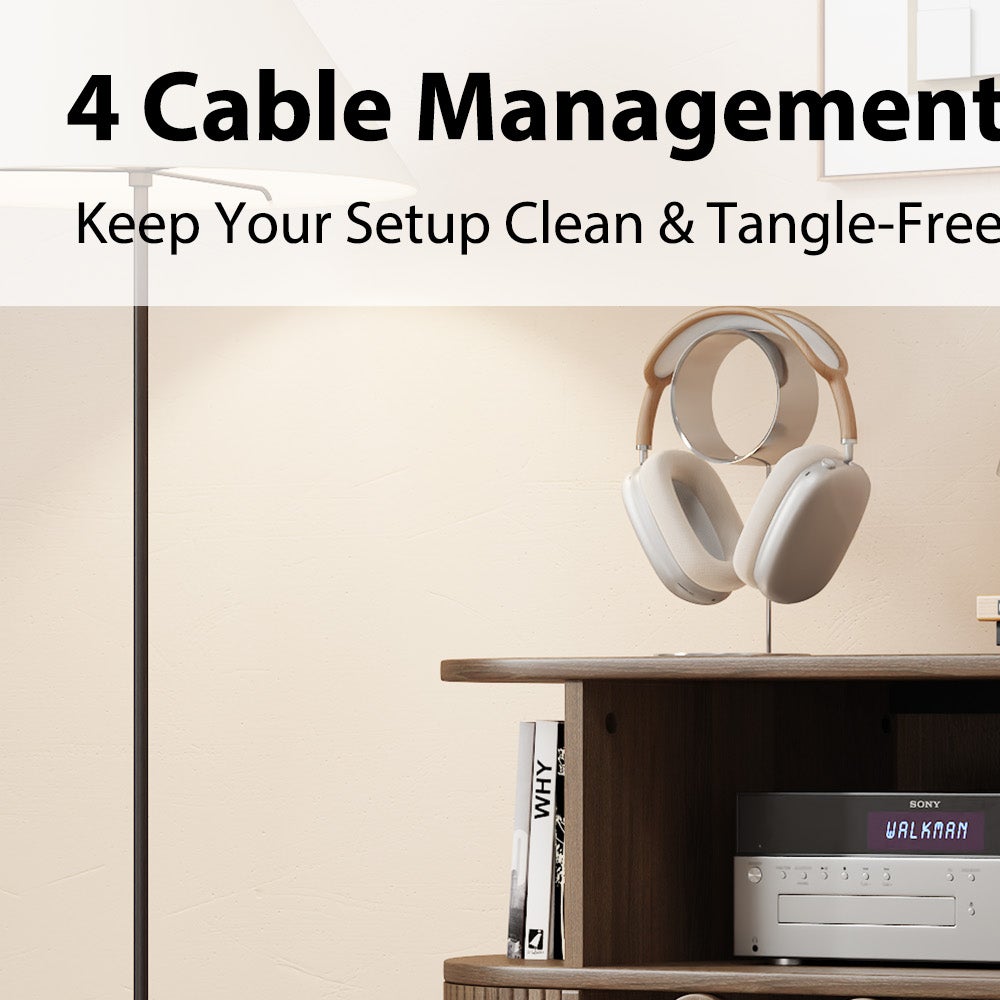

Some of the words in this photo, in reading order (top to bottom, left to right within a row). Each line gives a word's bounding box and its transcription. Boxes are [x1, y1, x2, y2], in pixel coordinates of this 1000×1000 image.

[534, 759, 552, 820] WHY
[909, 800, 941, 809] SONY
[885, 820, 969, 840] WALKMAN
